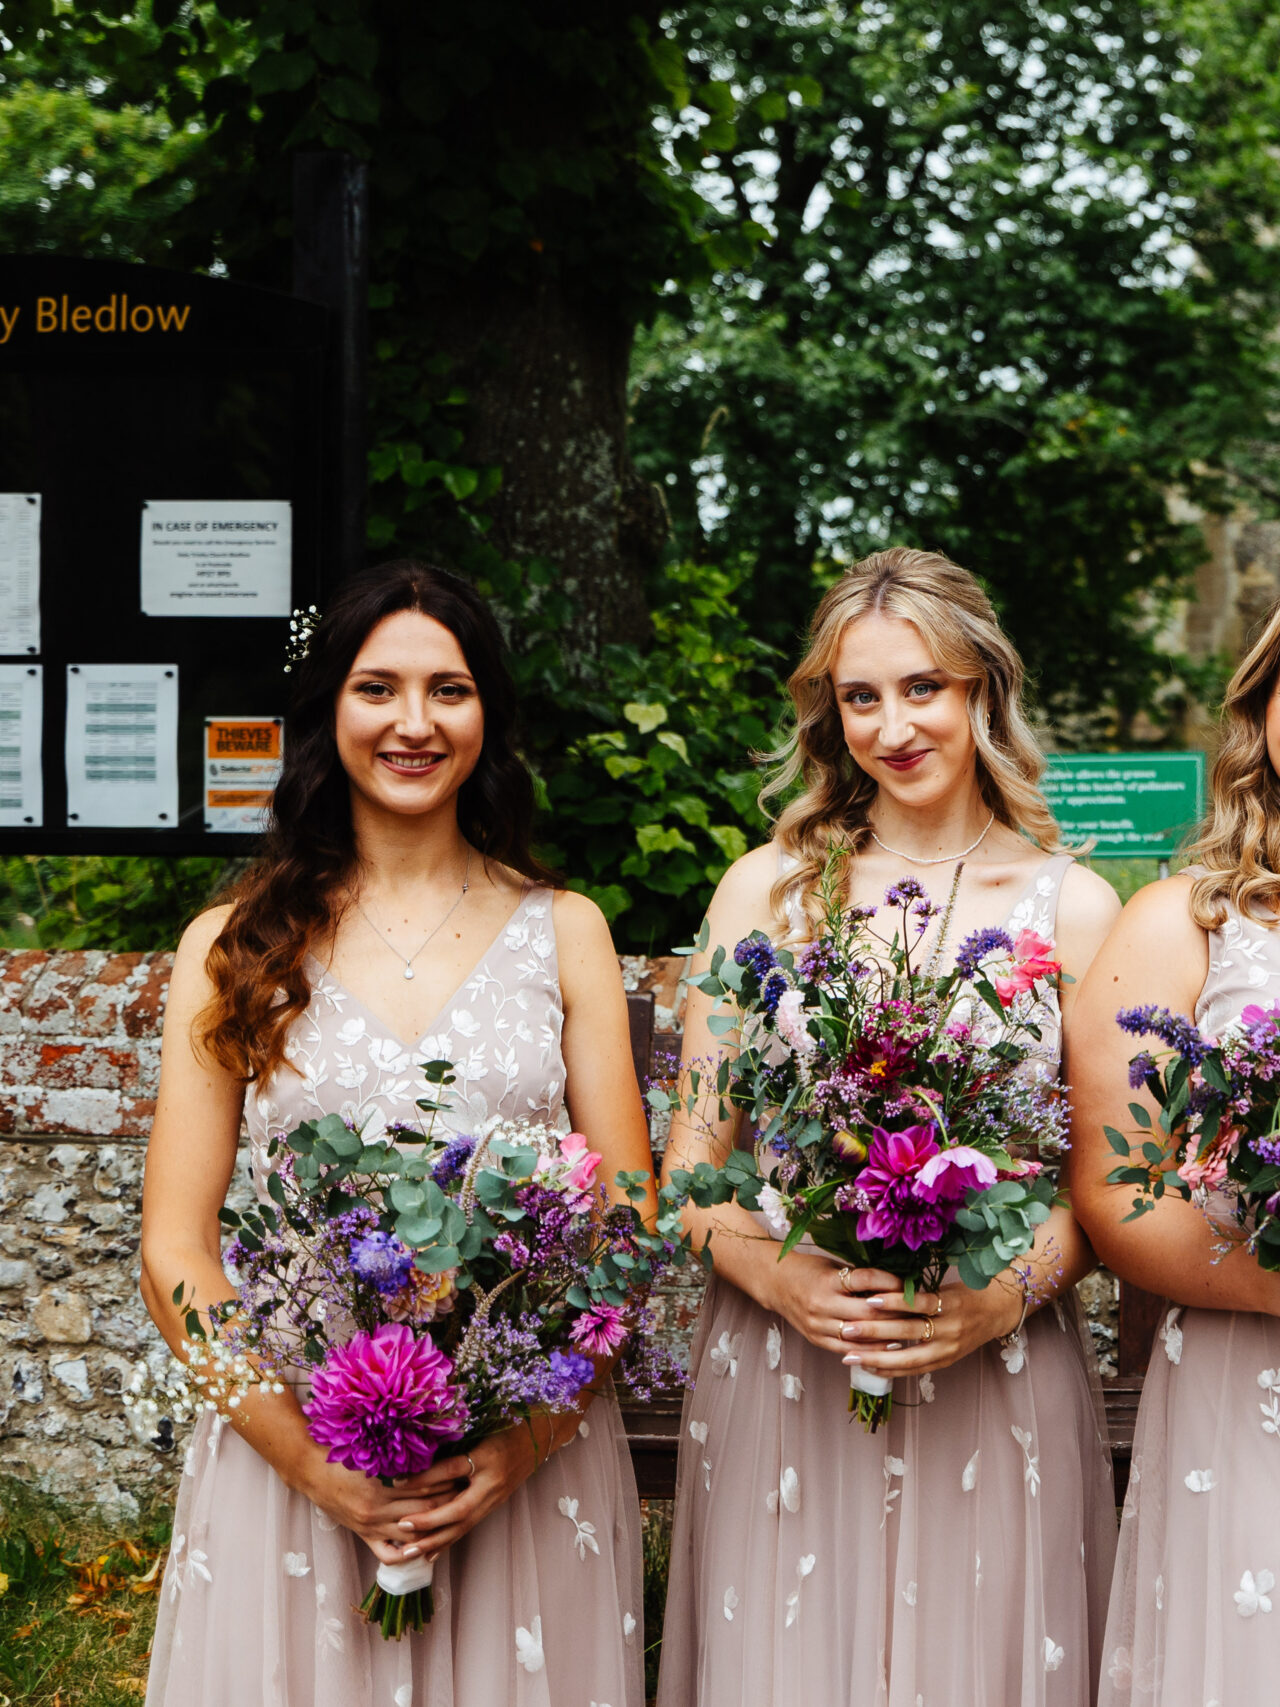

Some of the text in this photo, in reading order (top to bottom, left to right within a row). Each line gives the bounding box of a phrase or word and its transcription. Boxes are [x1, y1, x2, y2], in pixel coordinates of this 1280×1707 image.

[37, 294, 190, 333] Bledlow
[152, 521, 279, 532] IN CASE OF EMERGENCY
[217, 727, 272, 740] THIEVES
[216, 740, 271, 752] BEWARE
